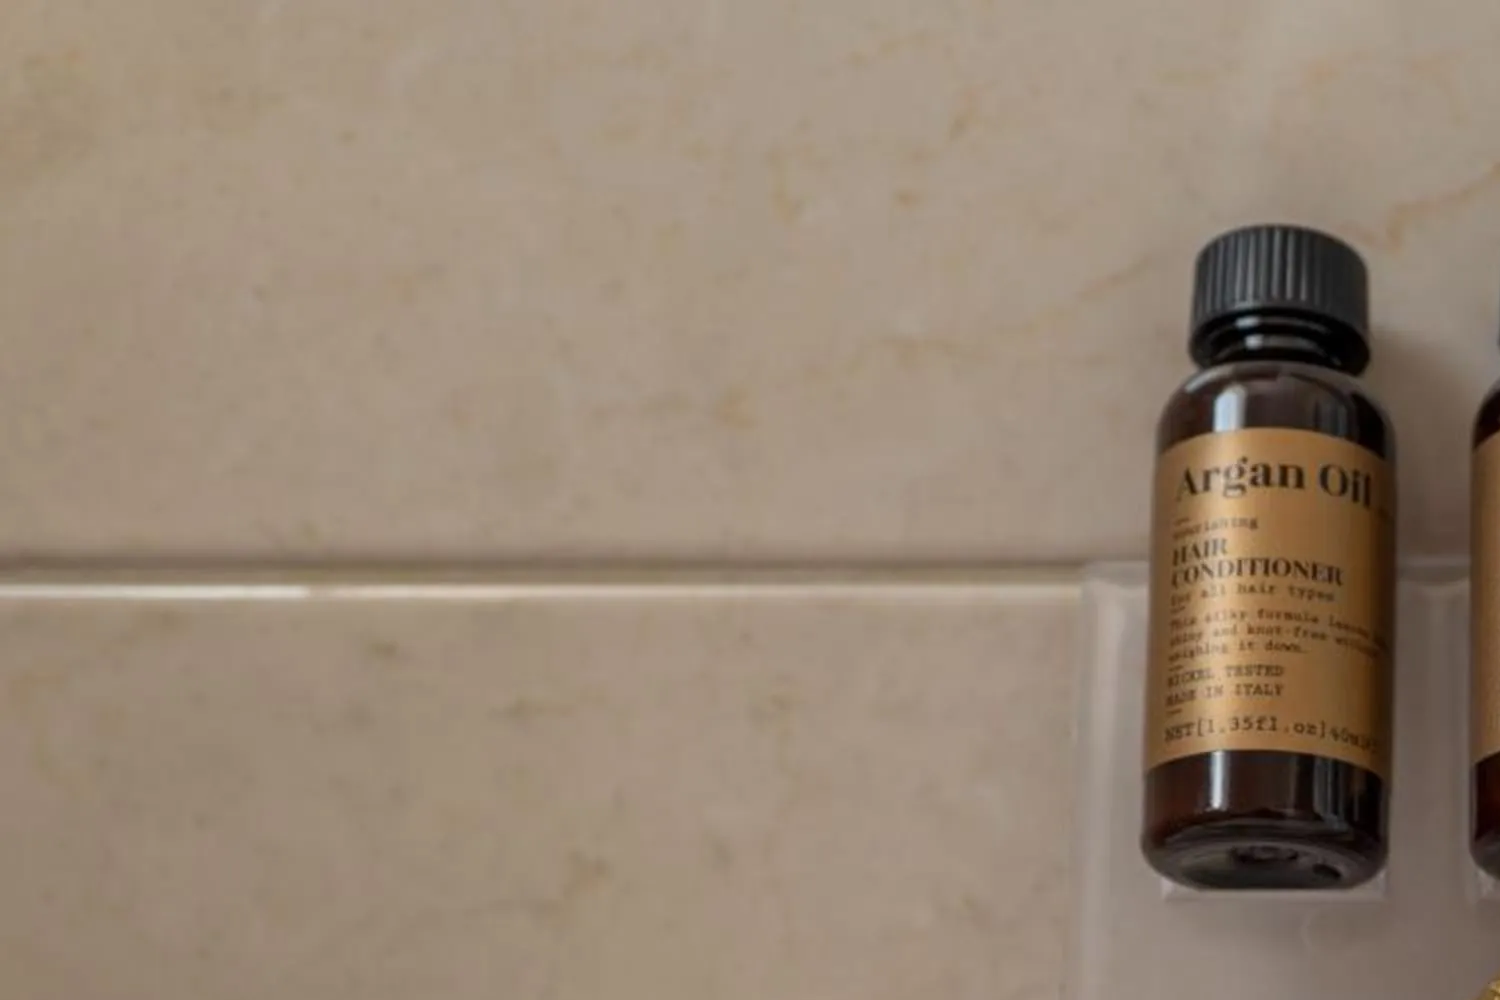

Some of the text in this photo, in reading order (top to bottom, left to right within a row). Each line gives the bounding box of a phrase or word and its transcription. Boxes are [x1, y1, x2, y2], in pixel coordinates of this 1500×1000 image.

[1176, 456, 1372, 510] Argan Oil
[1172, 537, 1228, 567] HAIR
[1171, 557, 1345, 589] CONDITIONER
[1200, 583, 1226, 598] all
[1236, 582, 1276, 597] hair
[1287, 584, 1336, 602] types
[1224, 664, 1285, 679] TESTED
[1234, 683, 1285, 697] ITALY
